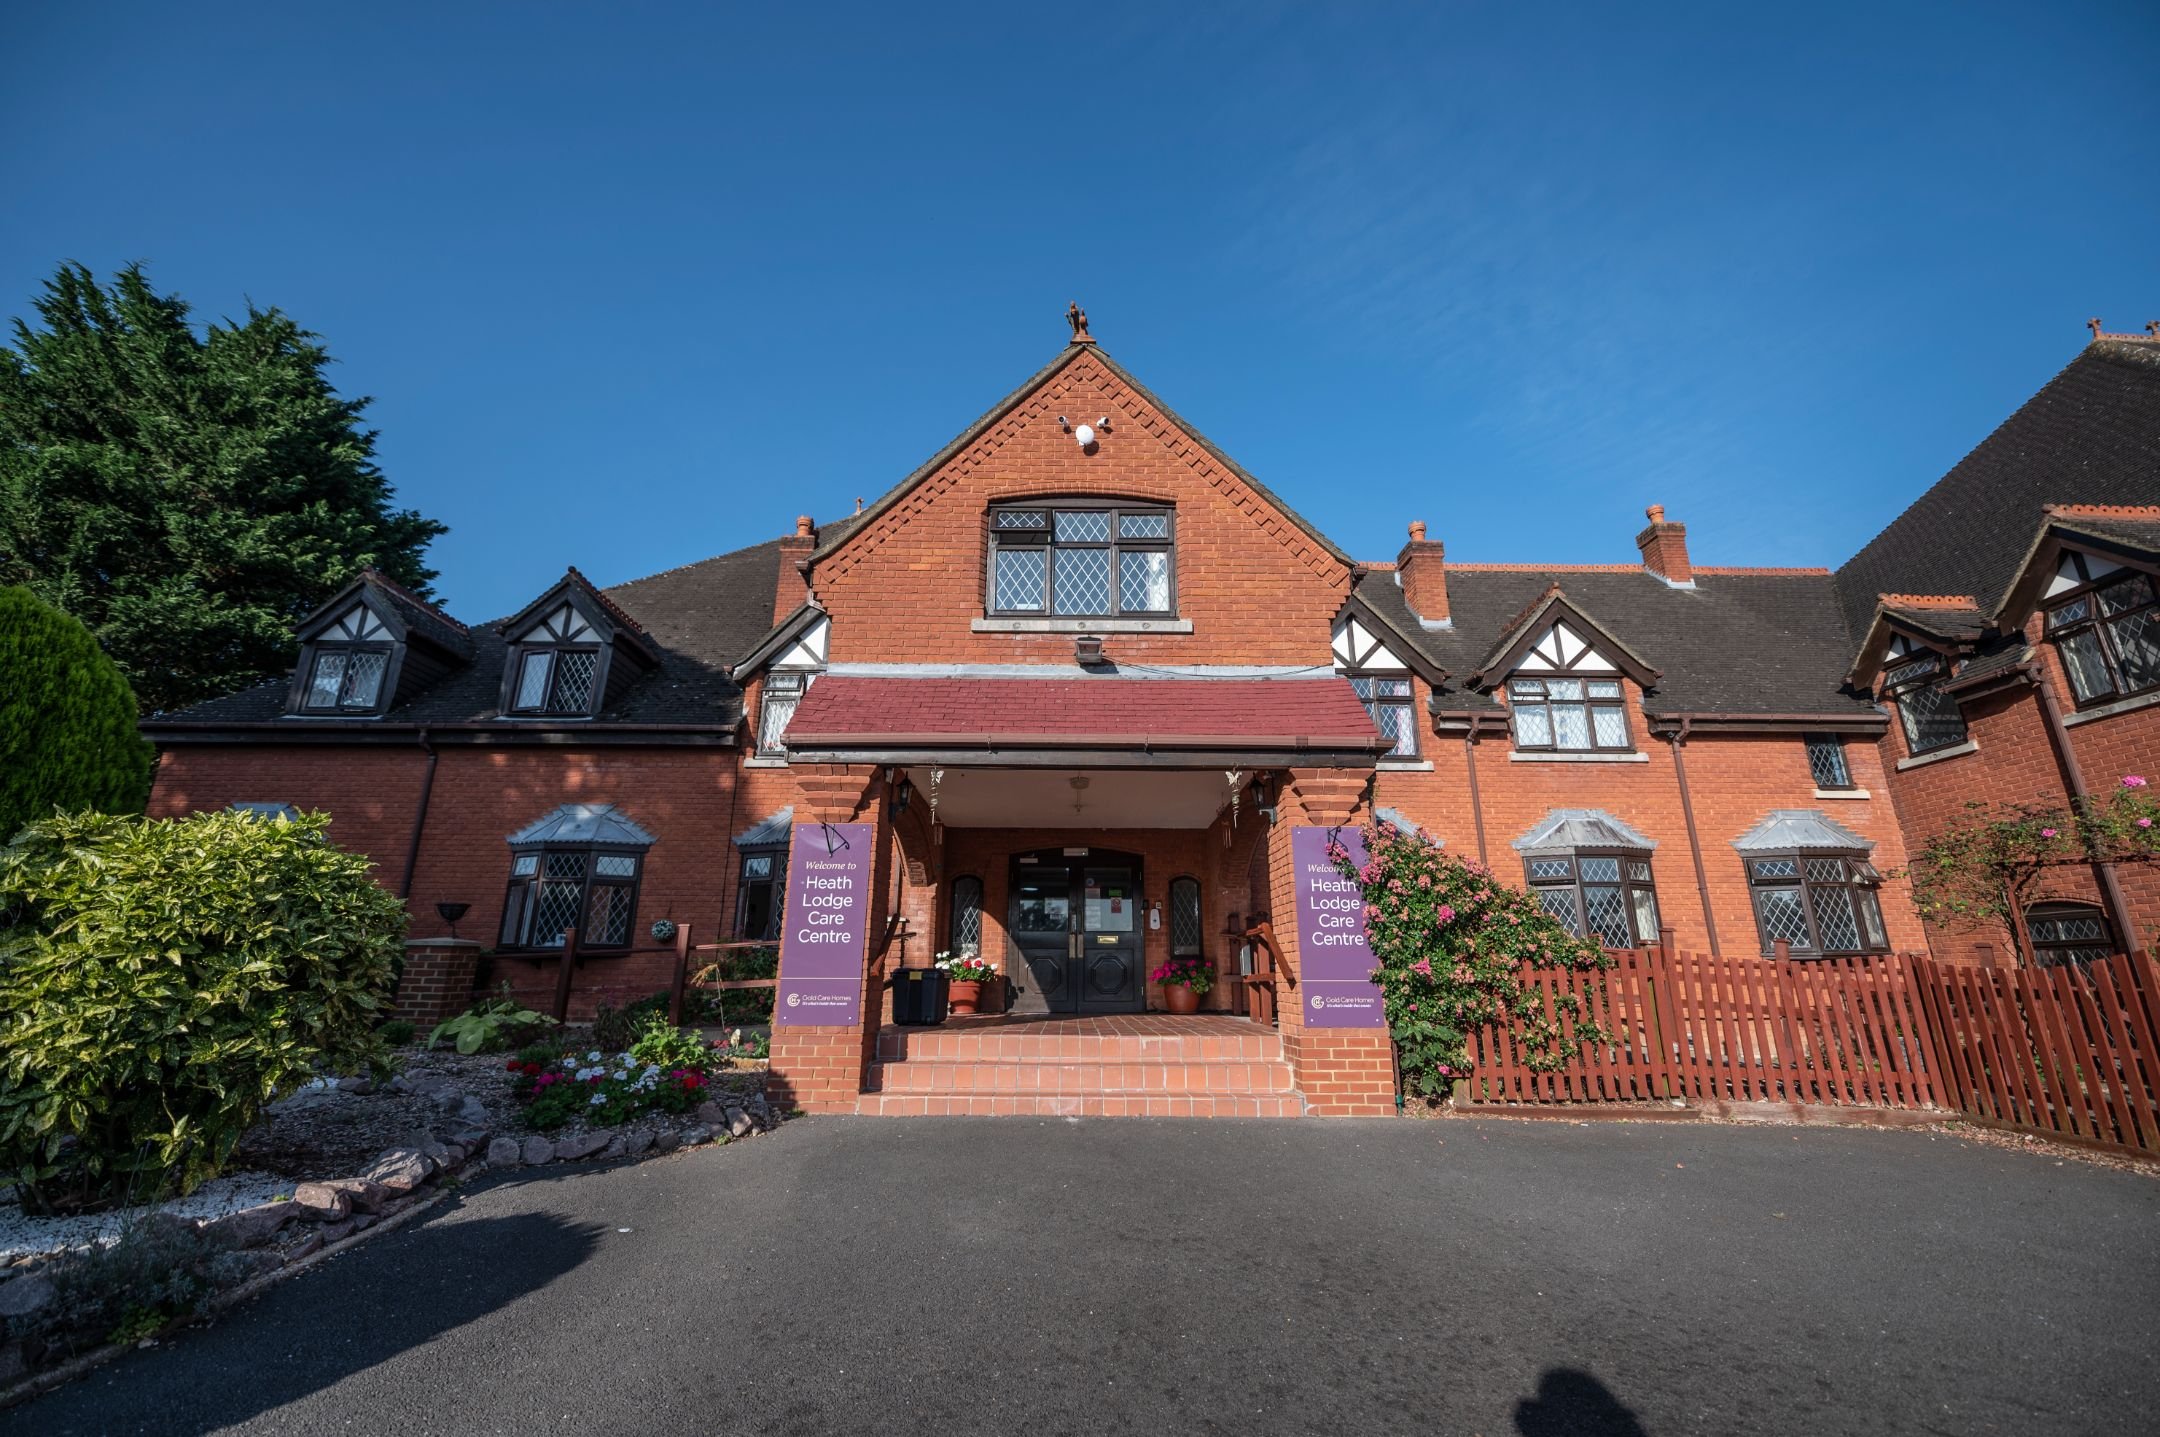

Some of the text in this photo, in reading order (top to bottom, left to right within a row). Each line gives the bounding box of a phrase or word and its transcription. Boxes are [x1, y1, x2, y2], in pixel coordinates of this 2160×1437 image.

[805, 861, 857, 870] Welcome to
[1307, 863, 1345, 873] Welco
[806, 875, 852, 889] Heath
[802, 893, 853, 909] Lodge
[1310, 896, 1360, 912] Lodge
[808, 911, 845, 925] Care
[1318, 914, 1355, 928] Care
[798, 929, 851, 943] Centre
[1311, 931, 1364, 946] Centre
